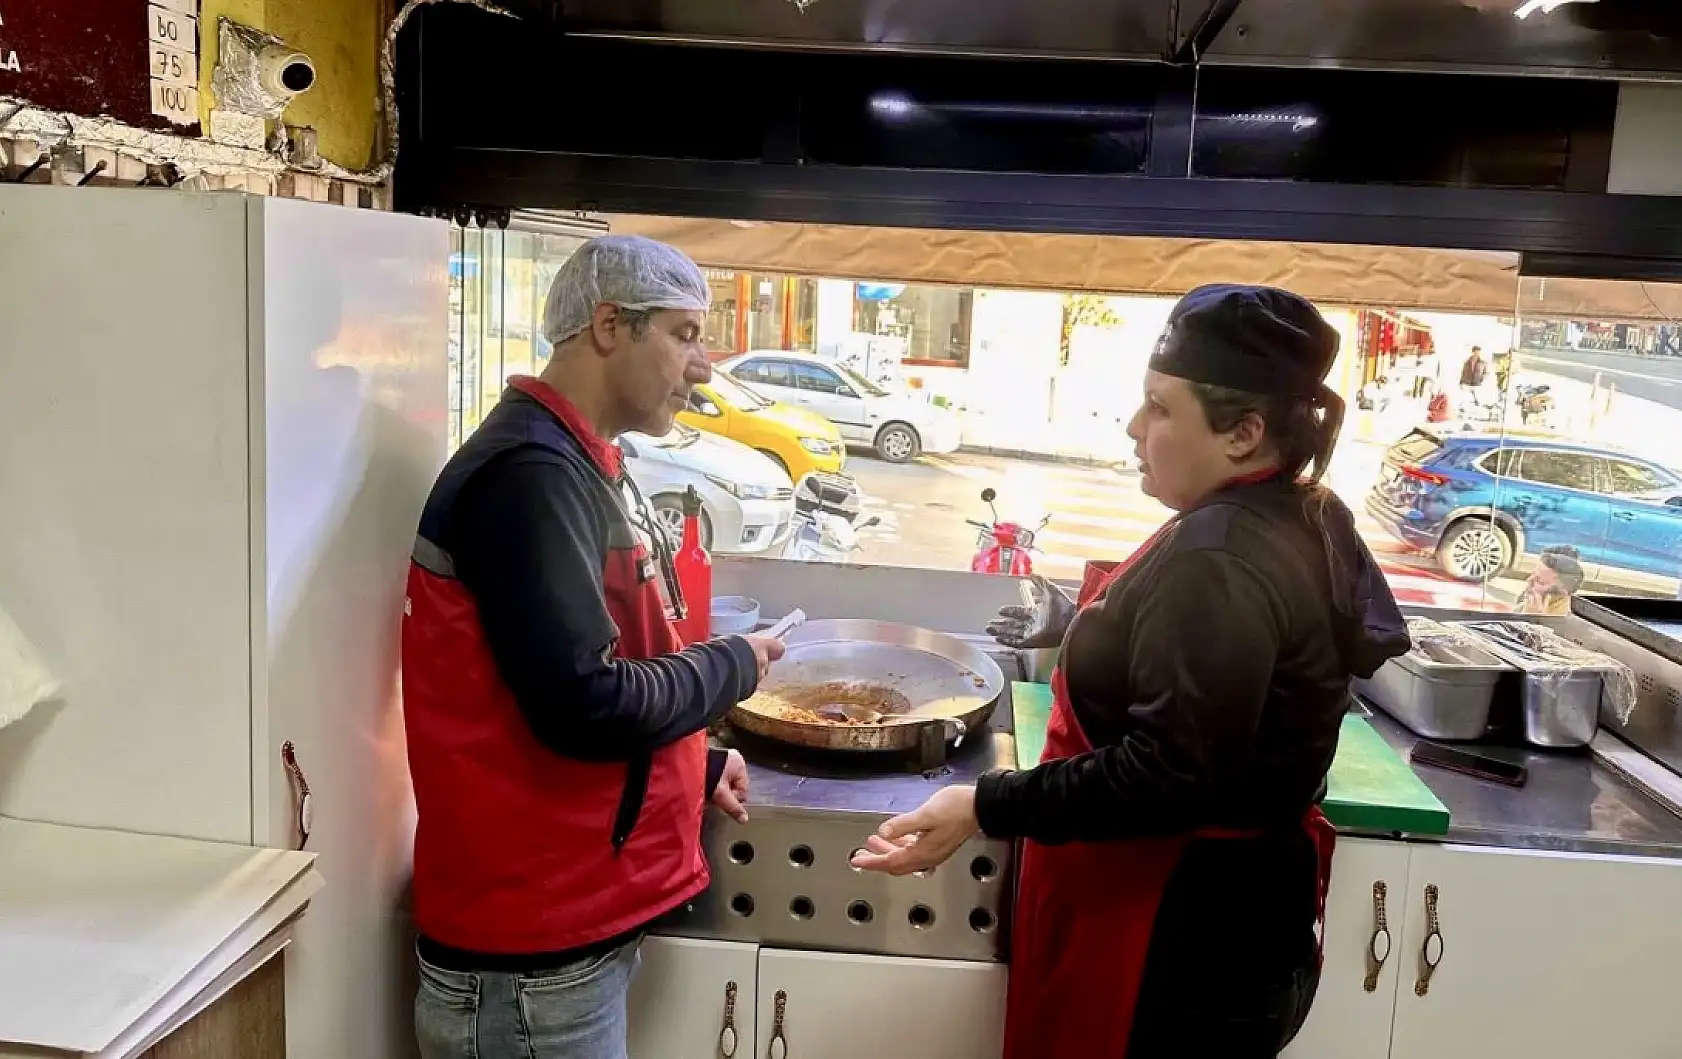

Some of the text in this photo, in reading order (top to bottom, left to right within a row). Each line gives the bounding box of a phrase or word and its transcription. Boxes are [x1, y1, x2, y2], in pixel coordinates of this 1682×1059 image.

[157, 14, 177, 41] 60
[156, 51, 182, 77] 75
[161, 87, 187, 111] 100
